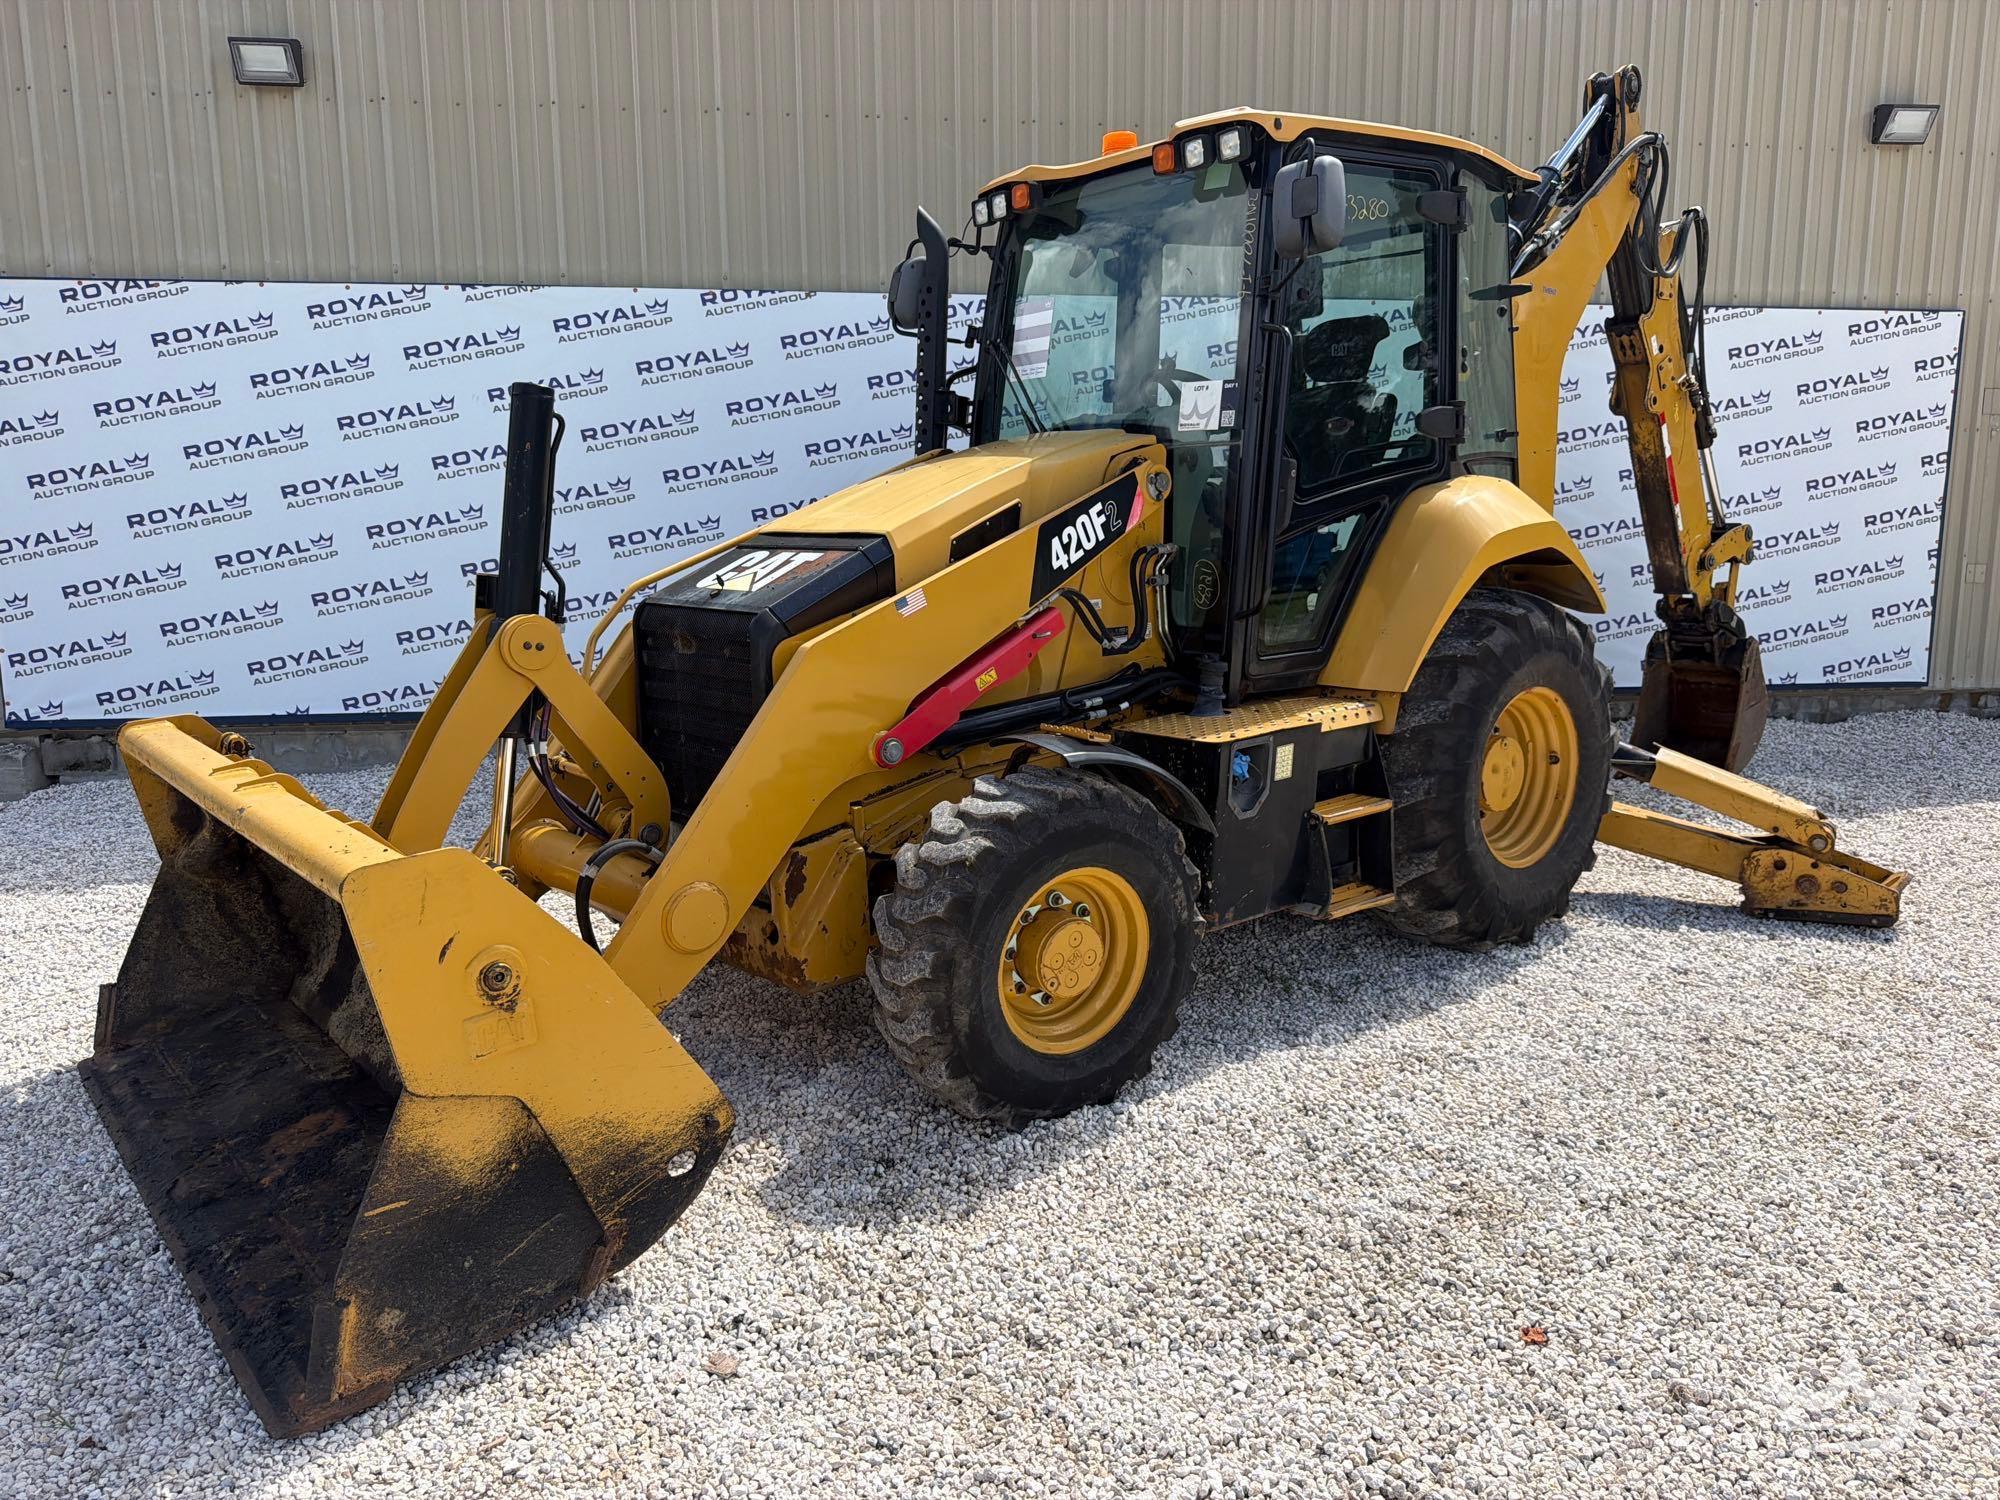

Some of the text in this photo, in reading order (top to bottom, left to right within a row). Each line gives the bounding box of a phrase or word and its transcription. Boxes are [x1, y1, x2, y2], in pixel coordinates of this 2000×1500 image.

[66, 286, 189, 315] AUCTION GROUP
[307, 291, 404, 320] ROYAL
[465, 285, 529, 303] AUCTION
[313, 302, 432, 331] AUCTION GROUP
[552, 305, 646, 333] ROYAL
[705, 299, 767, 318] AUCTION
[150, 319, 250, 348] ROYAL
[558, 316, 673, 344] AUCTION GROUP
[779, 322, 870, 350] ROYAL
[1065, 328, 1109, 345] GROUP
[1849, 313, 1922, 337] ROYAL
[1850, 323, 1942, 347] AUCTION GROUP
[157, 330, 279, 359] AUCTION GROUP
[403, 332, 498, 361] ROYAL
[409, 343, 525, 372] AUCTION GROUP
[785, 333, 895, 361] AUCTION GROUP
[1728, 336, 1803, 361] ROYAL
[1730, 346, 1824, 371] AUCTION GROUP
[68, 358, 121, 374] GROUP
[250, 360, 347, 389] ROYAL
[635, 348, 727, 376] ROYAL
[641, 360, 754, 387] AUCTION GROUP
[256, 371, 375, 400] AUCTION GROUP
[559, 385, 608, 401] GROUP
[1797, 372, 1870, 397] ROYAL
[1799, 382, 1891, 406] AUCTION GROUP
[93, 388, 193, 418] ROYAL
[100, 399, 222, 429] AUCTION GROUP
[336, 402, 432, 431] ROYAL
[726, 389, 815, 416] ROYAL
[731, 400, 841, 427] AUCTION GROUP
[1733, 406, 1773, 419] GROUP
[343, 413, 460, 442] AUCTION GROUP
[580, 415, 673, 443] ROYAL
[1856, 409, 1928, 434] ROYAL
[1858, 418, 1948, 443] AUCTION GROUP
[11, 428, 65, 444] GROUP
[183, 431, 281, 460] ROYAL
[586, 426, 699, 453] AUCTION GROUP
[804, 430, 893, 458] ROYAL
[1557, 439, 1609, 455] AUCTION
[1738, 433, 1812, 458] ROYAL
[190, 442, 309, 471] AUCTION GROUP
[431, 443, 506, 470] ROYA
[809, 441, 917, 468] AUCTION GROUP
[1741, 442, 1833, 467] AUCTION GROUP
[26, 460, 126, 490] ROYAL
[280, 470, 376, 499] ROYAL
[438, 462, 500, 481] AUCTION
[662, 457, 753, 484] ROYAL
[668, 467, 779, 495] AUCTION GROUP
[1806, 468, 1878, 493] ROYAL
[34, 471, 155, 501] AUCTION GROUP
[287, 481, 404, 510] AUCTION GROUP
[1553, 491, 1595, 505] GROUP
[1808, 477, 1898, 502] AUCTION GROUP
[126, 500, 224, 529] ROYAL
[587, 494, 635, 509] GROUP
[1743, 502, 1783, 515] GROUP
[1863, 503, 1934, 528] ROYAL
[133, 510, 253, 540] AUCTION GROUP
[366, 511, 461, 540] ROYAL
[372, 521, 488, 550] AUCTION GROUP
[608, 522, 699, 550] ROYAL
[1051, 500, 1122, 571] 420F2
[1866, 521, 1915, 537] AUCTION
[0, 530, 70, 555] OYAL
[47, 540, 99, 556] GROUP
[614, 532, 725, 560] AUCTION GROUP
[1749, 528, 1822, 553] ROYAL
[1802, 537, 1841, 551] GROUP
[214, 540, 311, 570] ROYAL
[221, 550, 339, 580] AUCTION GROUP
[61, 570, 159, 600] ROYAL
[696, 550, 824, 592] CAT
[1815, 561, 1885, 586] ROYAL
[1817, 570, 1905, 595] AUCTION GROUP
[68, 580, 187, 610] AUCTION GROUP
[311, 578, 406, 607] ROYAL
[317, 588, 433, 618] AUCTION GROUP
[1753, 595, 1792, 609] GROUP
[1596, 611, 1654, 633] OYAL
[1871, 596, 1931, 620] ROYA
[1873, 612, 1921, 629] AUCTION
[159, 608, 256, 637] ROYAL
[166, 618, 284, 648] AUCTION GROUP
[396, 618, 472, 645] ROYA
[1757, 621, 1829, 646] ROYAL
[7, 638, 104, 668] ROYAL
[402, 637, 464, 656] AUCTION
[1760, 629, 1849, 655] AUCTION GROUP
[14, 648, 132, 679] AUCTION GROUP
[247, 647, 342, 676] ROYAL
[254, 656, 369, 686] AUCTION GROUP
[1823, 652, 1893, 677] ROYAL
[1875, 661, 1913, 675] GROUP
[95, 678, 192, 706] ROYAL
[103, 686, 220, 716] AUCTION GROUP
[342, 683, 435, 711] ROYAL
